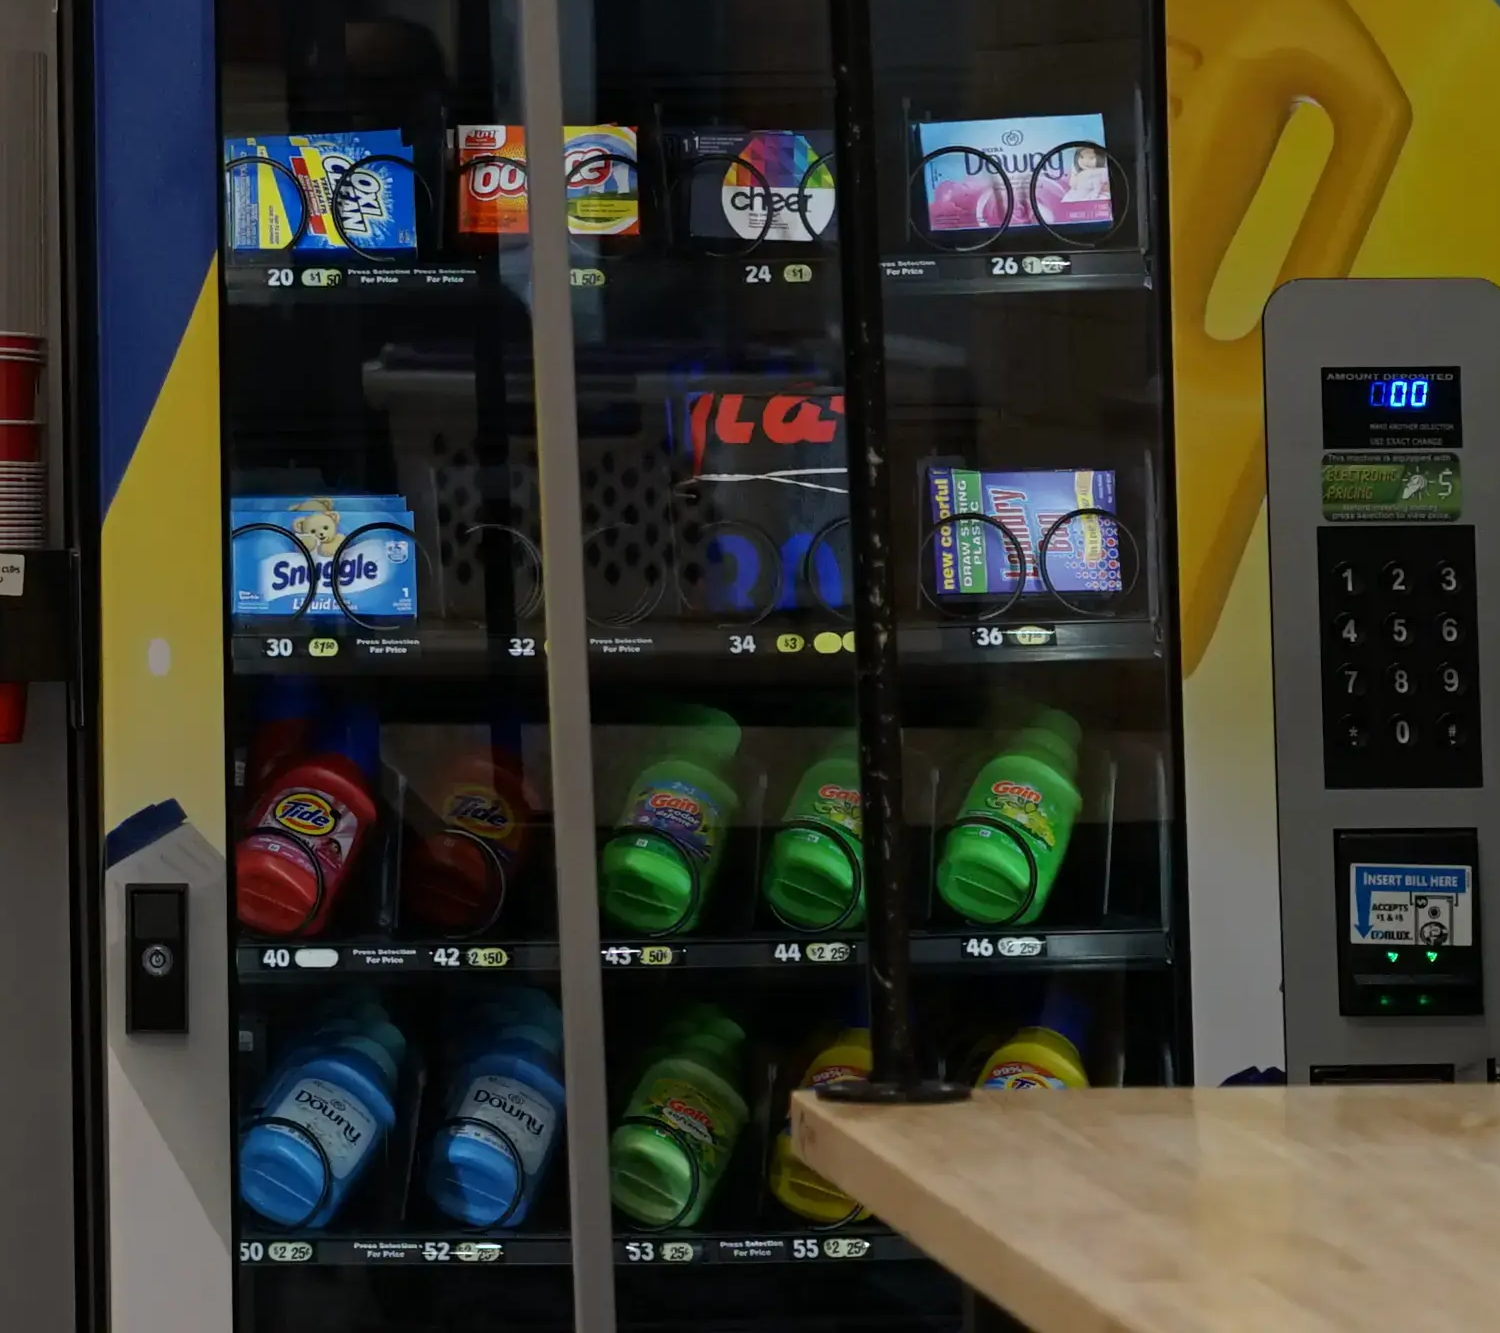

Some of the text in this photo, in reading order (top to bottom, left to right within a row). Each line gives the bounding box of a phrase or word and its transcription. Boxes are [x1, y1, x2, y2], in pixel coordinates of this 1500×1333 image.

[964, 150, 1067, 181] Downy
[349, 170, 383, 217] OXI
[731, 186, 813, 213] cheer
[744, 264, 773, 283] 24
[991, 257, 1018, 274] 26
[267, 268, 294, 287] 20
[1035, 511, 1073, 553] Bag
[272, 553, 379, 591] Snuggle
[266, 639, 293, 657] 30
[729, 636, 756, 654] 34
[990, 779, 1043, 804] Gain
[279, 801, 331, 829] Tide
[1363, 871, 1459, 888] INSERT BILL HERE
[1371, 903, 1409, 912] ACCEPTS
[433, 947, 461, 966] 42
[774, 945, 801, 962] 44
[966, 939, 994, 956] 46
[262, 948, 290, 967] 40
[294, 1088, 361, 1146] Downy
[473, 1088, 545, 1136] Downy
[240, 1243, 264, 1261] 50
[792, 1240, 819, 1258] 55
